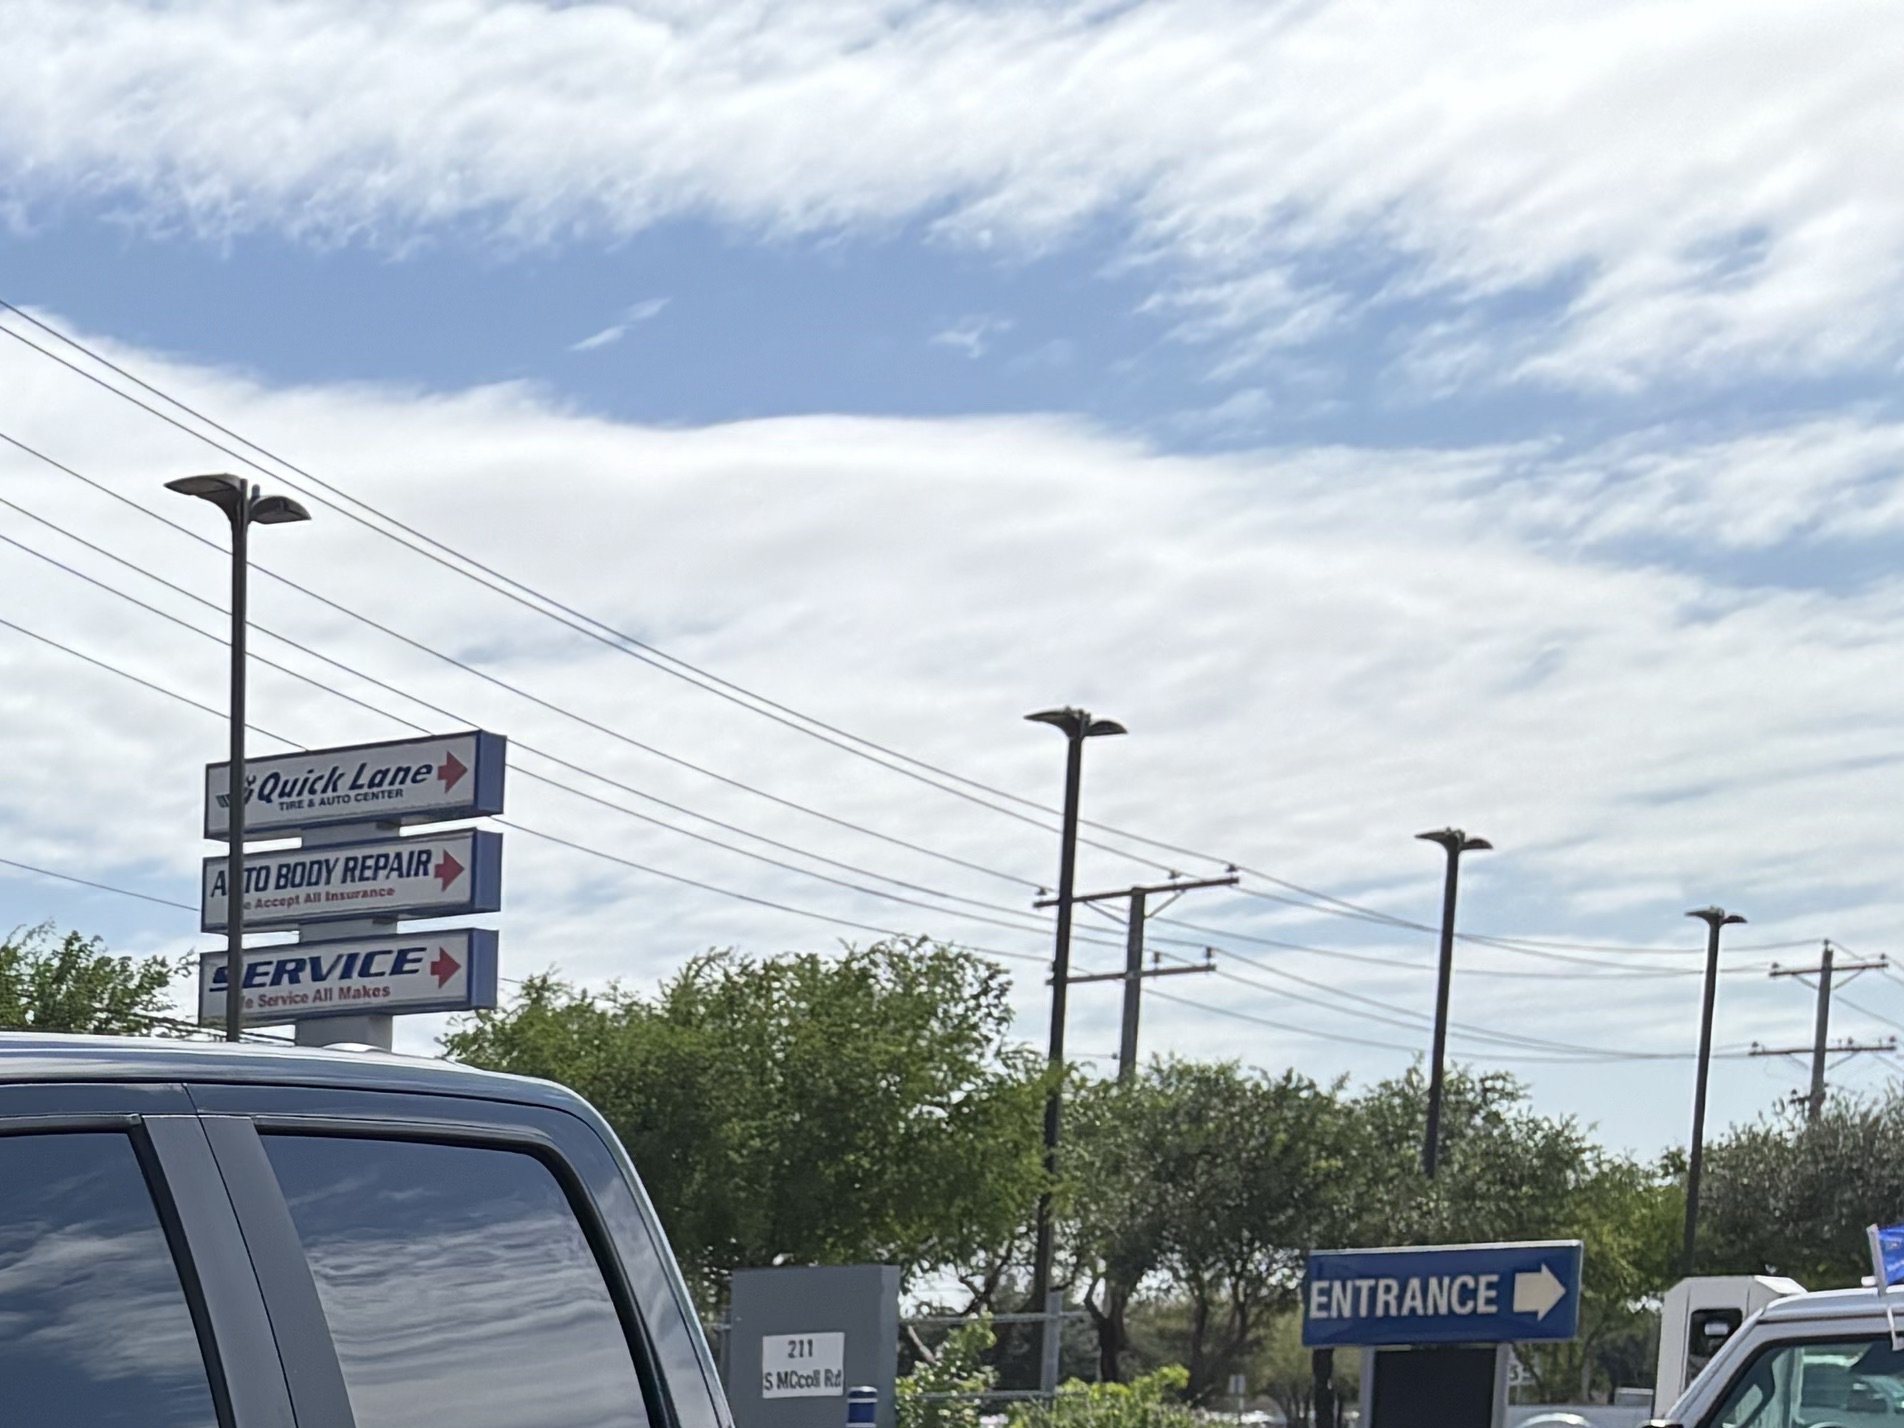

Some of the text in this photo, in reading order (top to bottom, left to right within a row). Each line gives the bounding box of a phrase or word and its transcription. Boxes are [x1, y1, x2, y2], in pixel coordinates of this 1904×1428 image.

[257, 763, 433, 803] Quick Lane
[279, 788, 404, 811] TIRE & AUTO CENTER
[210, 849, 433, 897] ATO BODY REPAIR
[254, 894, 300, 909] Accept
[304, 892, 321, 904] All
[325, 887, 396, 902] Insurance
[258, 991, 308, 1009] Service
[312, 988, 333, 1003] All
[338, 984, 391, 1000] Makes
[1308, 1274, 1500, 1319] ENTRANCE
[788, 1338, 814, 1358] 211
[764, 1370, 774, 1391] S
[824, 1368, 842, 1388] Rd
